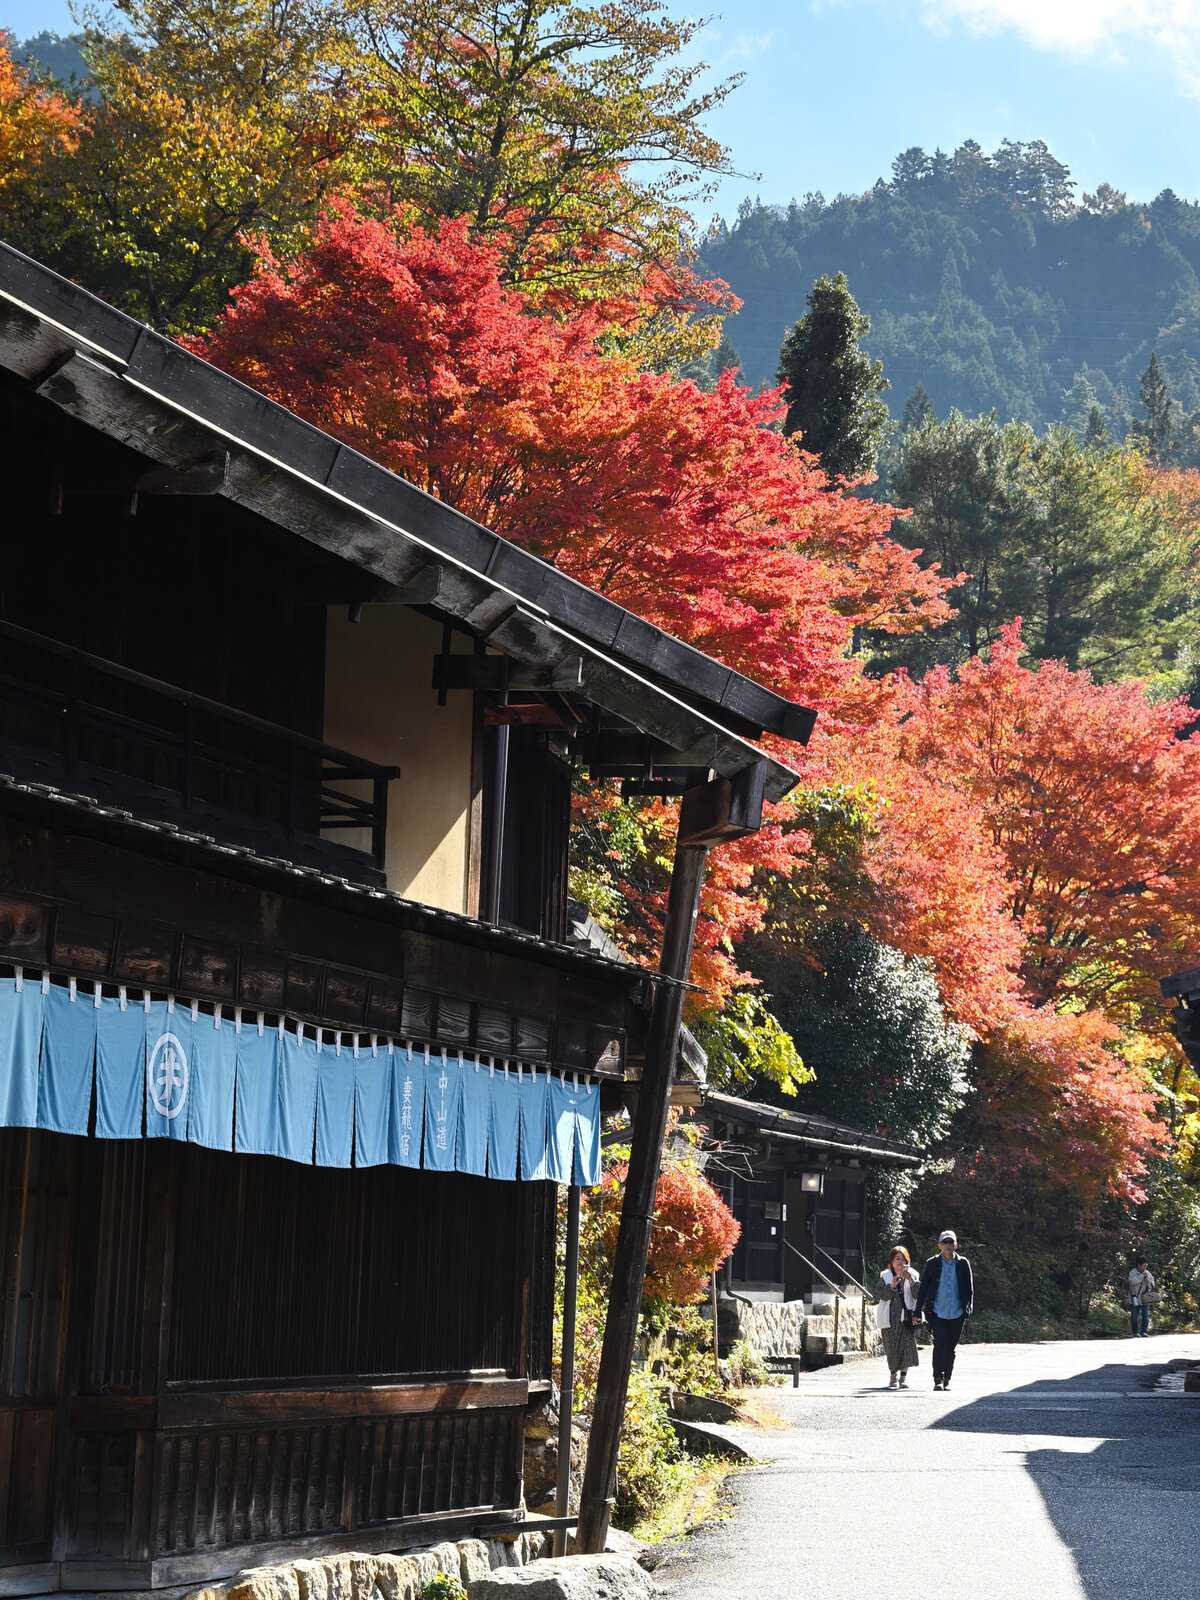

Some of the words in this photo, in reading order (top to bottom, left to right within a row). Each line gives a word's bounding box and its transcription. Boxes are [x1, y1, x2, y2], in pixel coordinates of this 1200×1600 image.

[400, 1075, 413, 1156] 妻籠宿
[436, 1070, 448, 1151] 中山道
